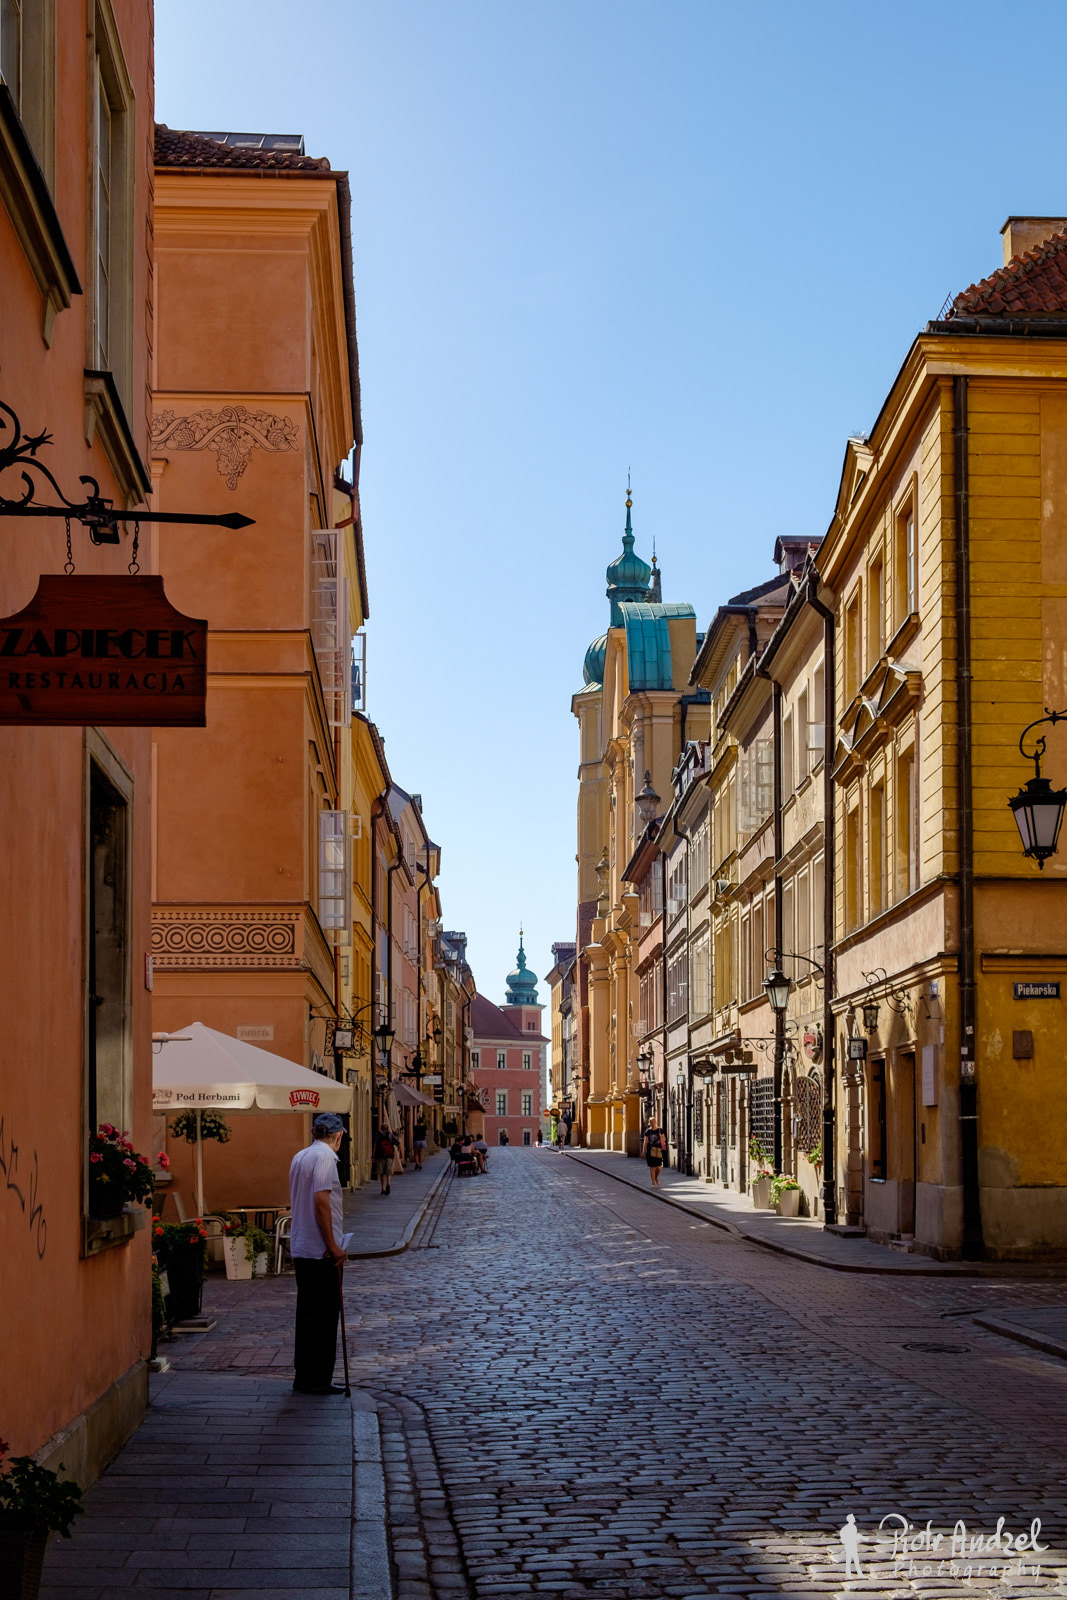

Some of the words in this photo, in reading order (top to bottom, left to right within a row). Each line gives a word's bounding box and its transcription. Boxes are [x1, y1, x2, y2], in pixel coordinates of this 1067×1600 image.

[0, 628, 197, 658] ZAPIECEK
[8, 672, 186, 693] RESTAURACJA
[1017, 983, 1057, 996] Piekarska
[852, 1044, 862, 1052] 25
[176, 1092, 195, 1101] Pod
[198, 1092, 240, 1101] Herbami
